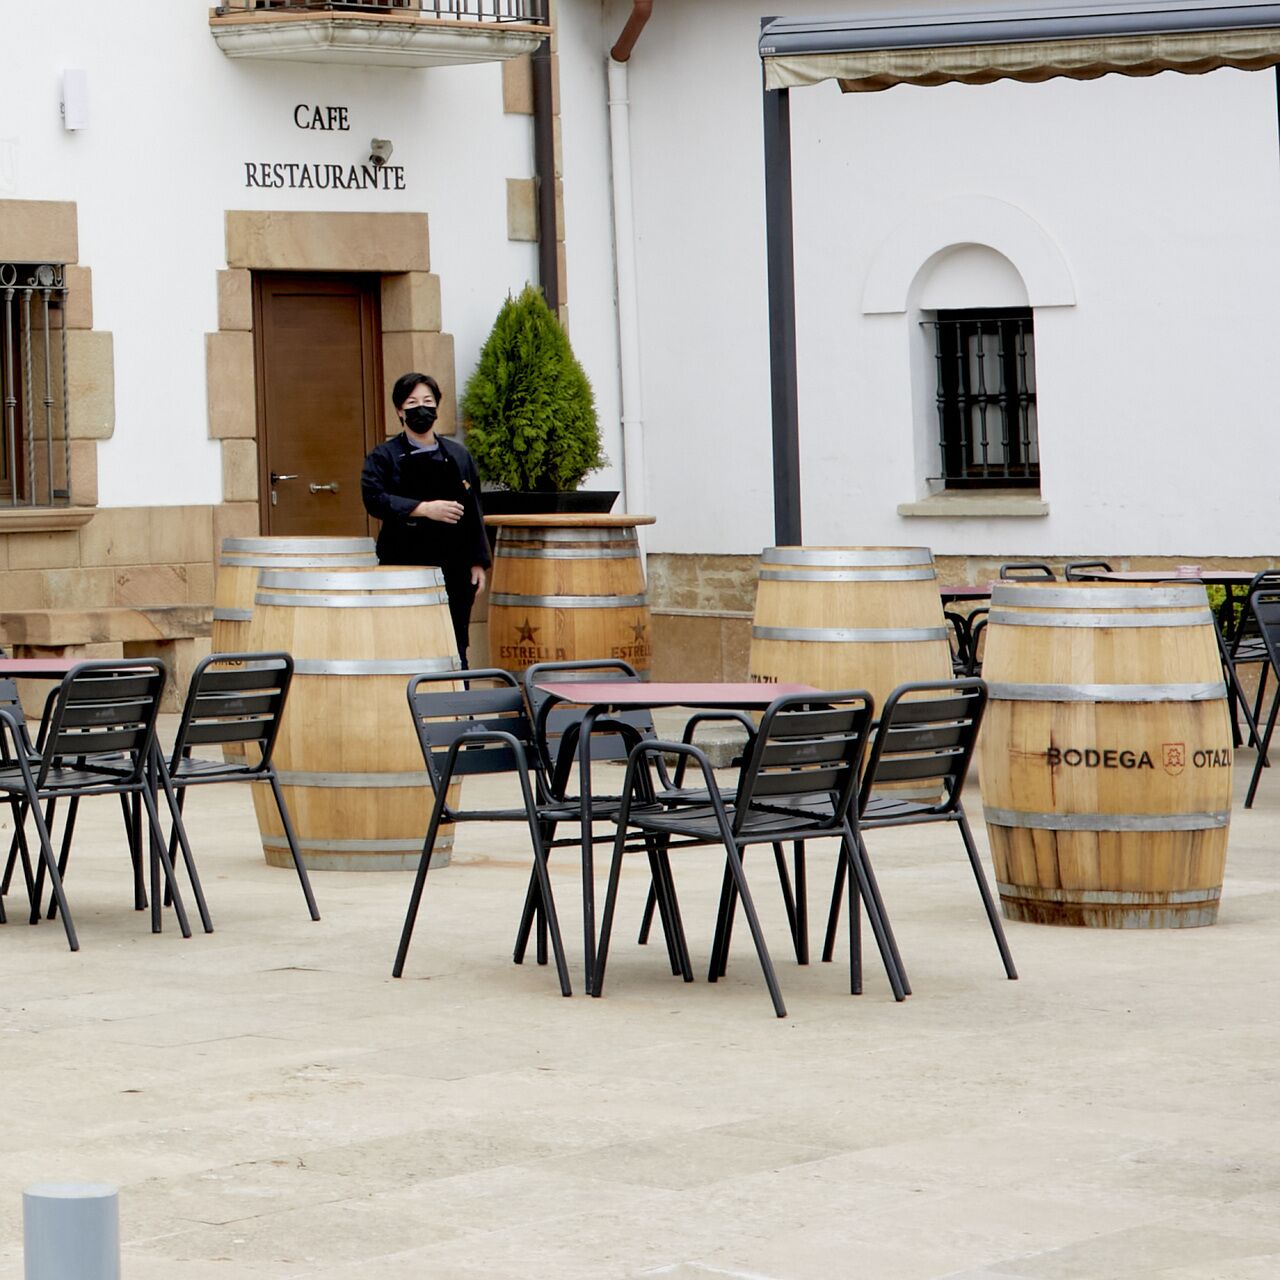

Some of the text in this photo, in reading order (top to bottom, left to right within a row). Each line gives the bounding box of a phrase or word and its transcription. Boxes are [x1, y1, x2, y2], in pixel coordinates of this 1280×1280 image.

[294, 104, 350, 131] CAFE
[244, 162, 406, 190] RESTAURANTE
[1047, 746, 1154, 769] BODEGA
